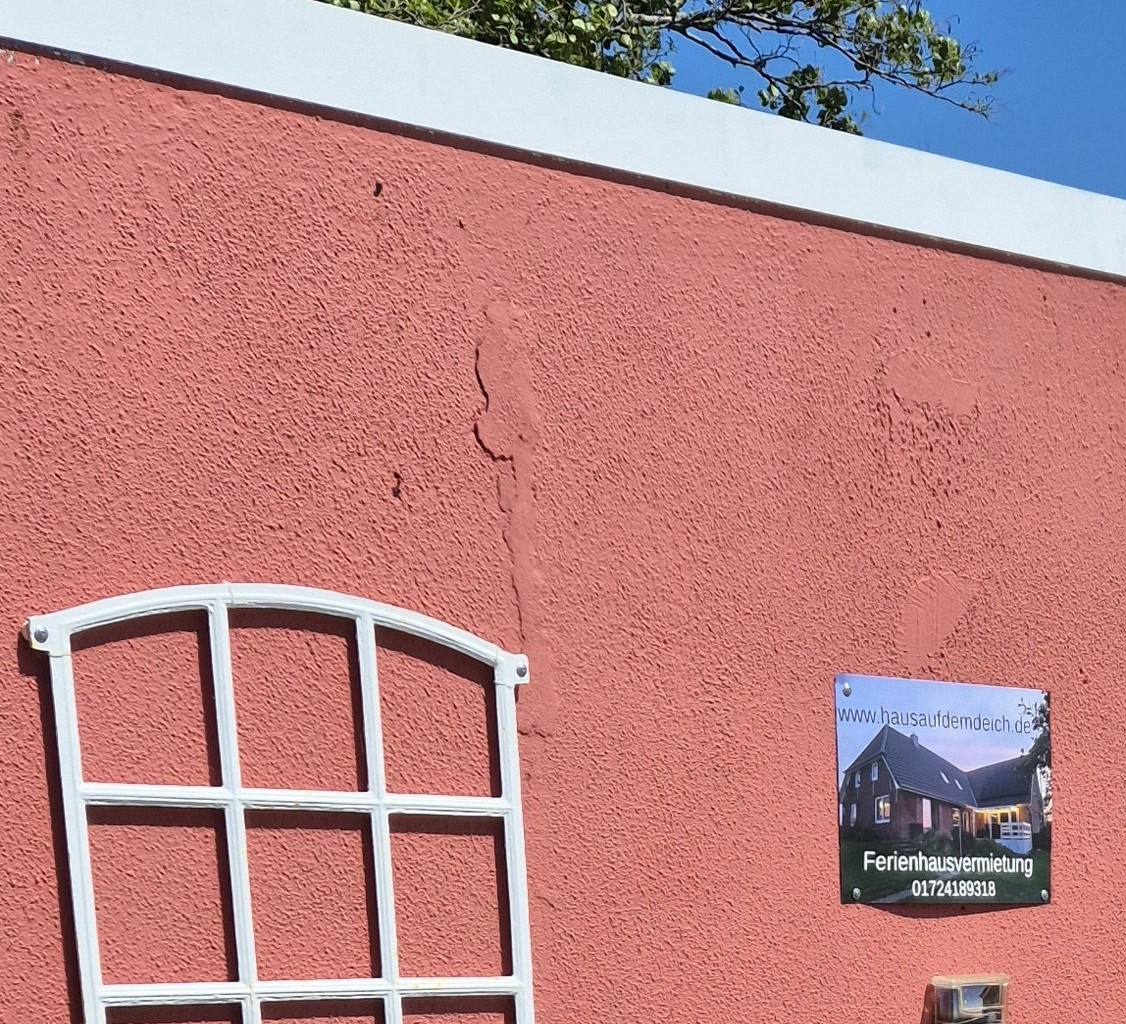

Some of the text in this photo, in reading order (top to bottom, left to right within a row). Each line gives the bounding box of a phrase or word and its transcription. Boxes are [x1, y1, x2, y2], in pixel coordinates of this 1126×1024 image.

[837, 706, 1031, 734] www.hausaufdemdeich.de
[863, 850, 1034, 878] Ferienhausvermietung
[911, 879, 996, 897] 01724189318
